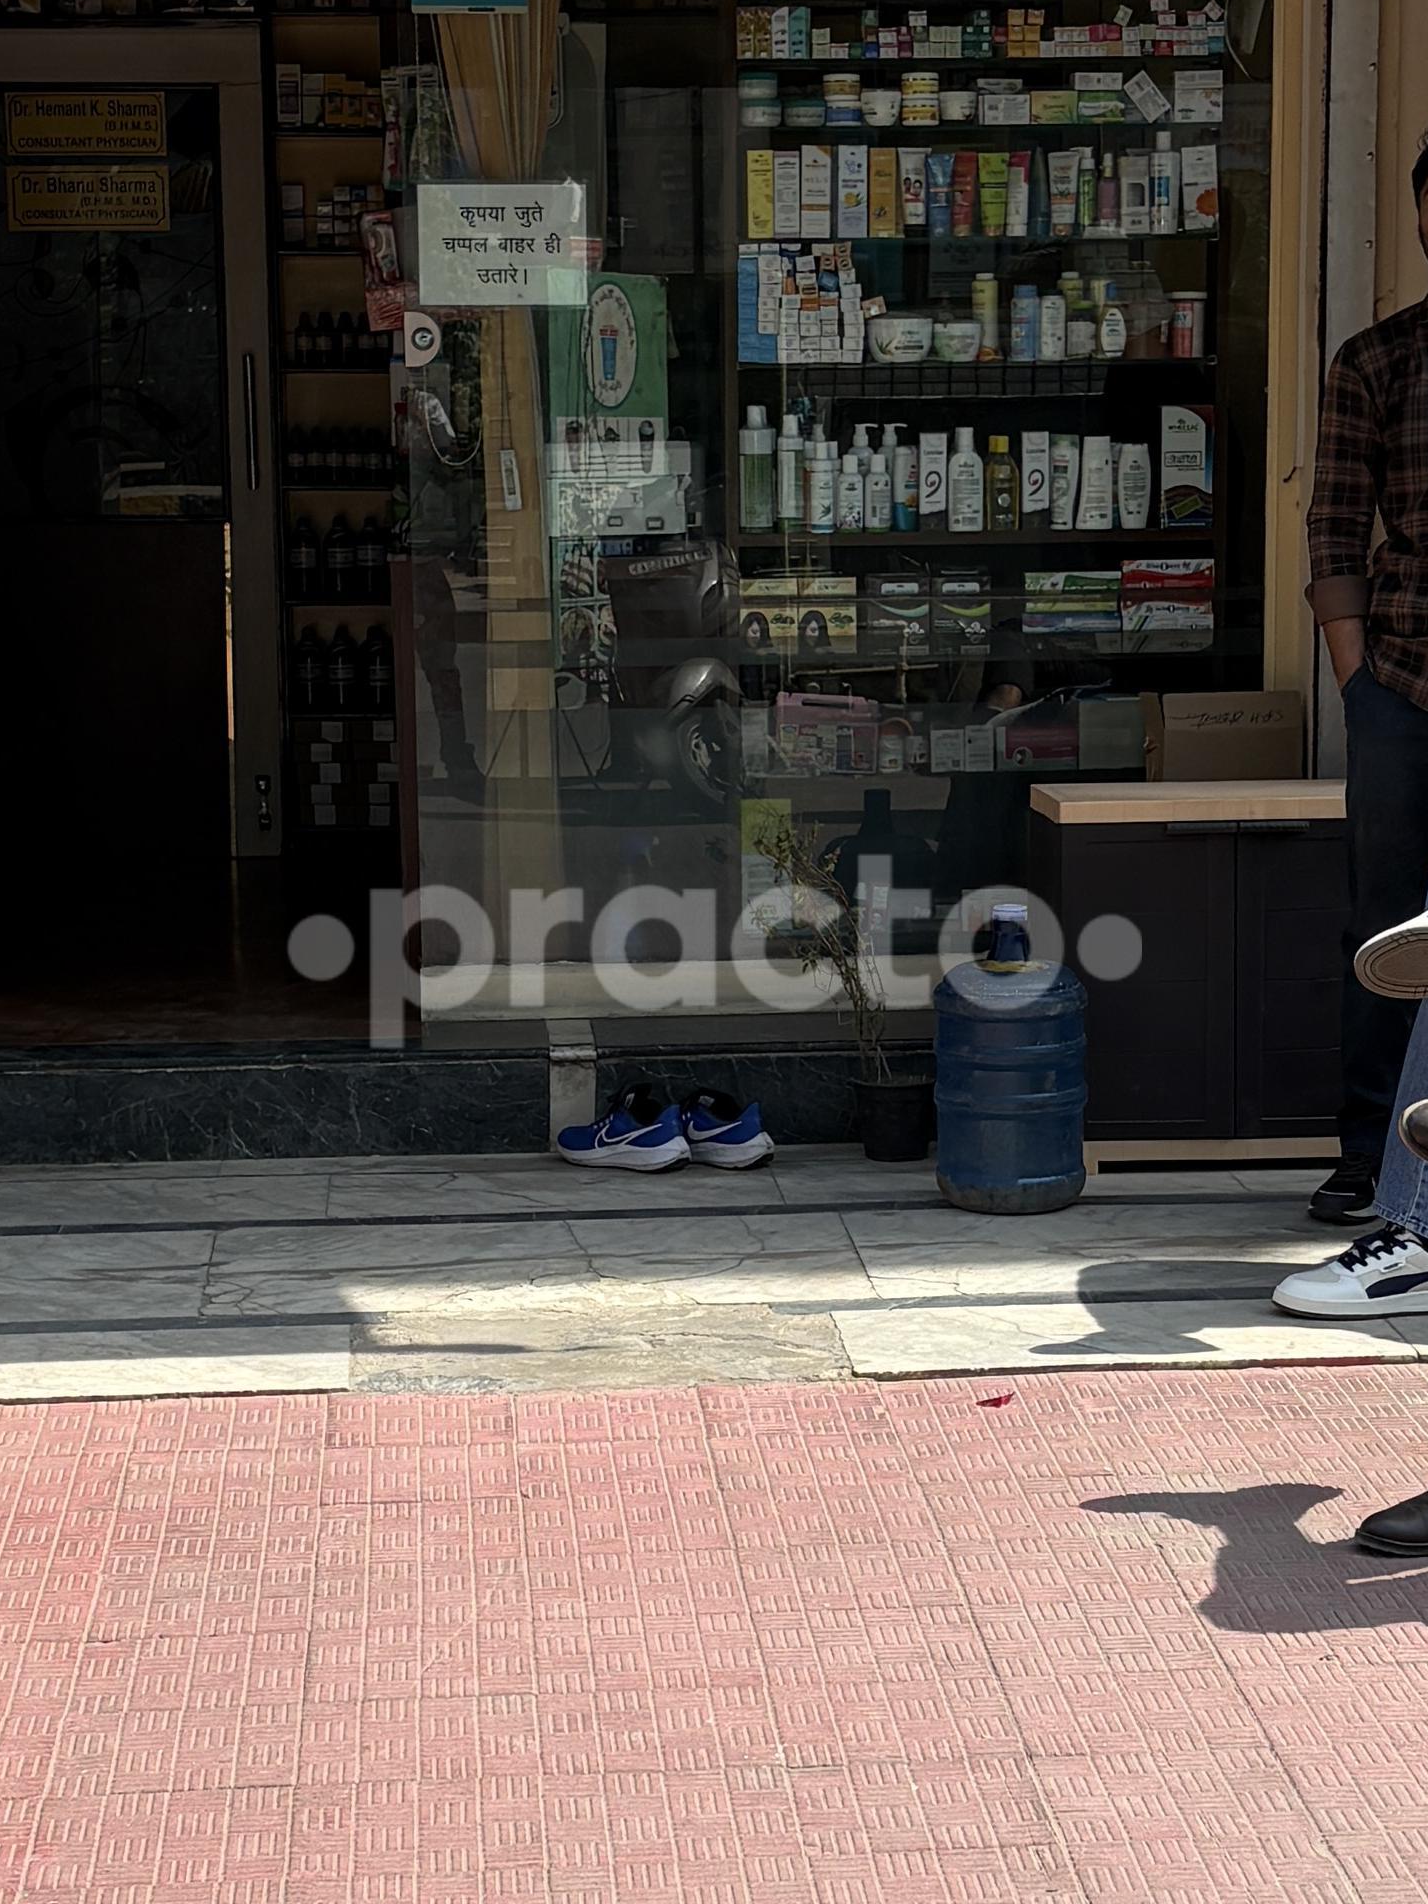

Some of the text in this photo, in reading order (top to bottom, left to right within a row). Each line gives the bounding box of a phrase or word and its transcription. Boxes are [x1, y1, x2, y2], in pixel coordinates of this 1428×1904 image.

[13, 99, 31, 117] Dr.
[35, 99, 87, 117] Hemant
[107, 99, 158, 117] Sharma
[18, 137, 157, 148] CONSULTANT PHYSICIAN
[22, 176, 156, 194] Dr. Bhanu Sharma
[460, 201, 545, 228] कृपया जुते
[442, 236, 488, 254] चप्पल
[544, 232, 562, 254] ही
